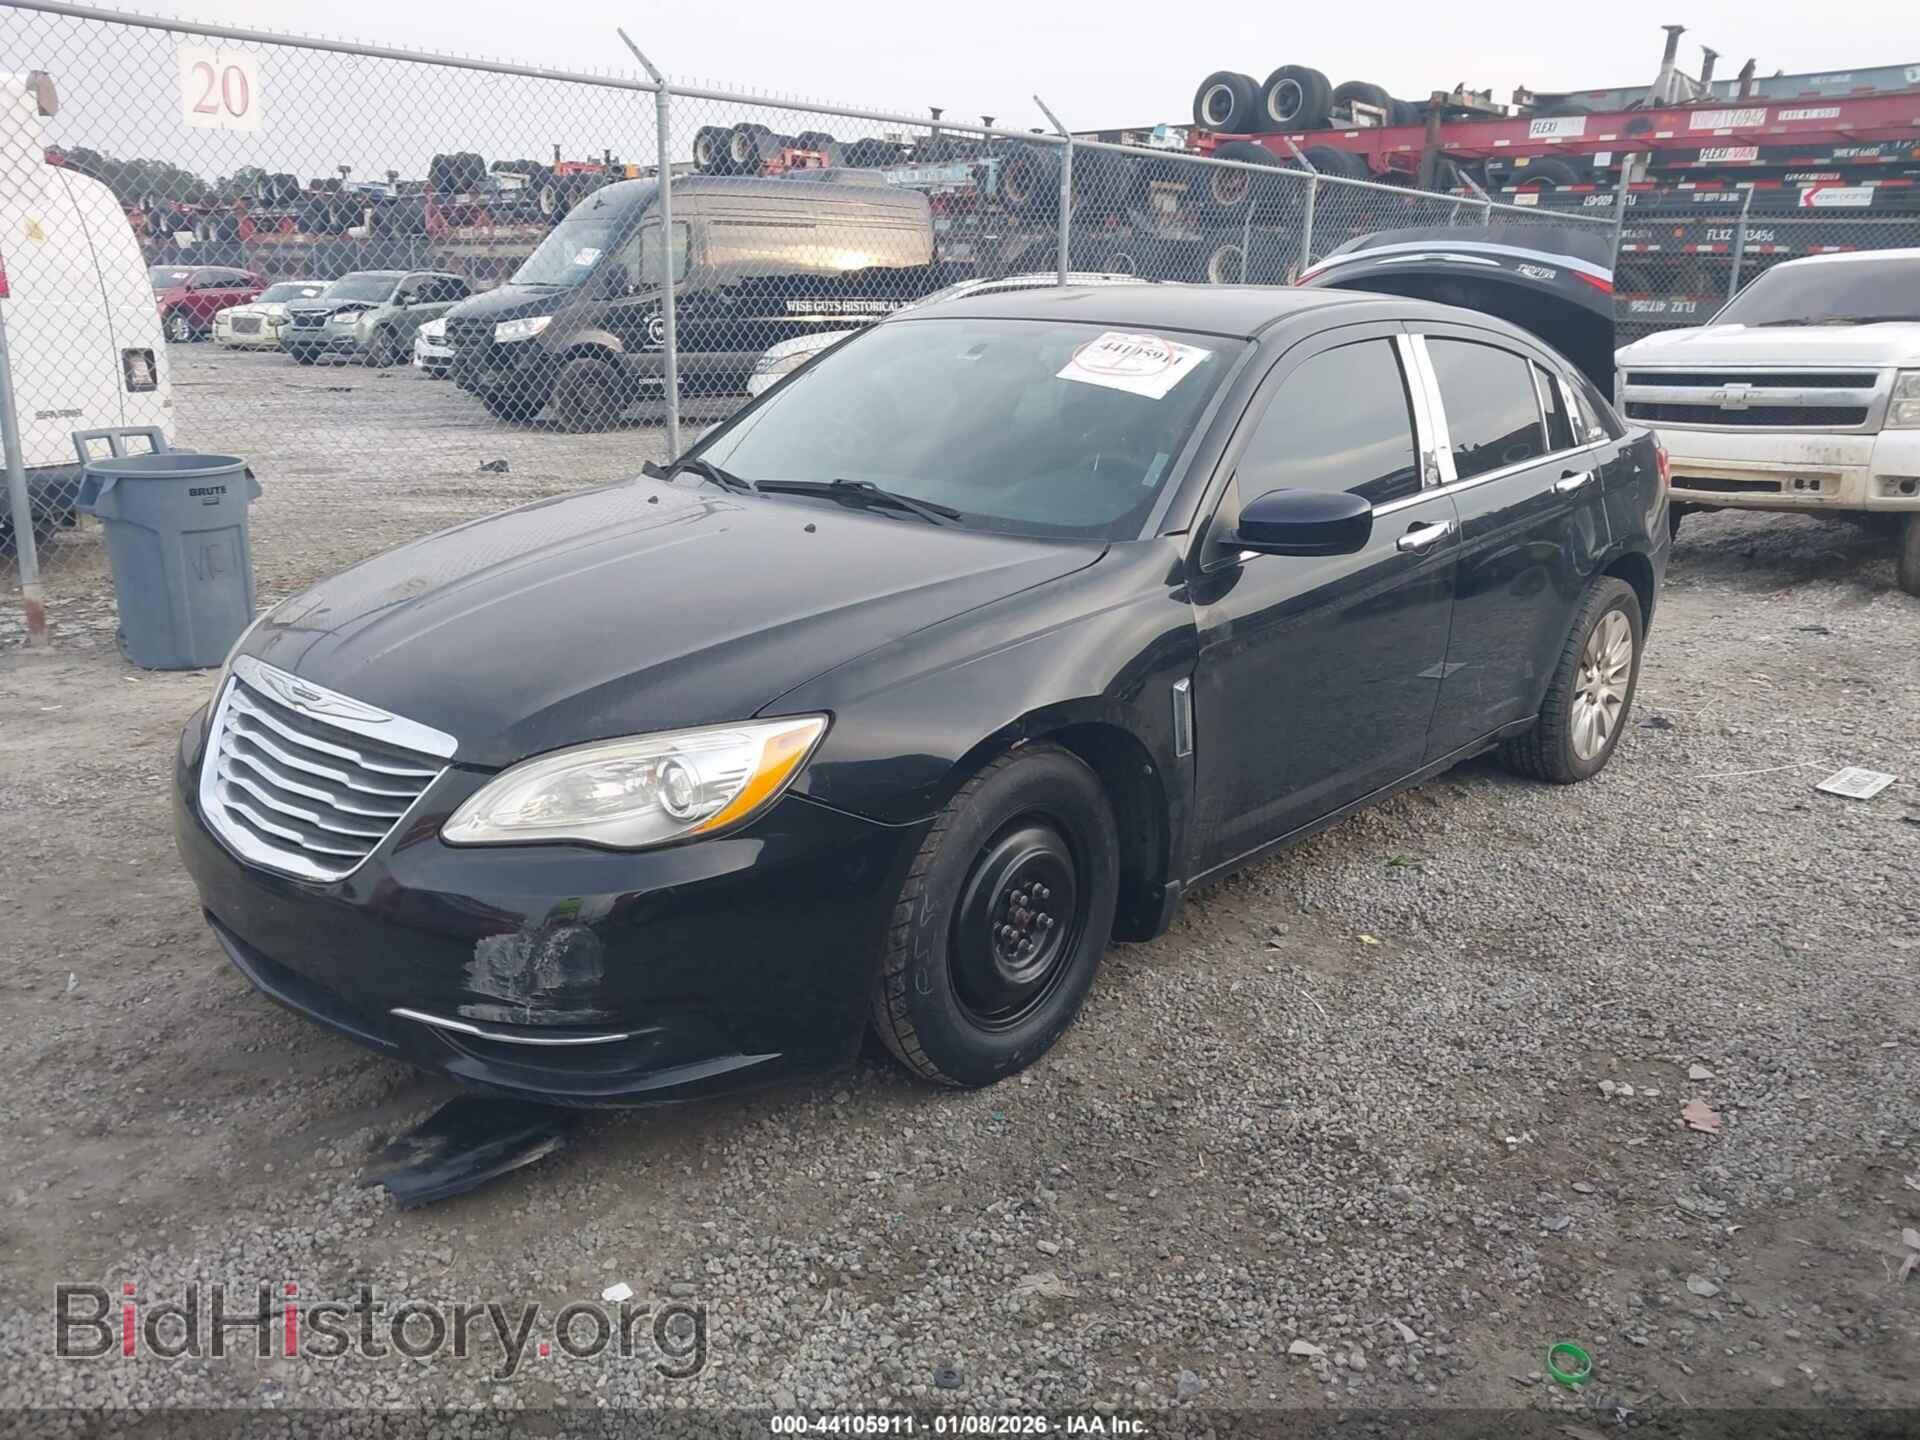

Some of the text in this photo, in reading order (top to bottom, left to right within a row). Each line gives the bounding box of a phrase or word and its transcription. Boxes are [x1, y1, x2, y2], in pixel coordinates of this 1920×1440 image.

[191, 61, 249, 117] 20
[1531, 121, 1557, 135] FLEXI
[786, 301, 812, 312] WISE
[813, 301, 842, 312] GUYS
[842, 301, 898, 312] HISTORICAL
[188, 485, 228, 497] BRUTE
